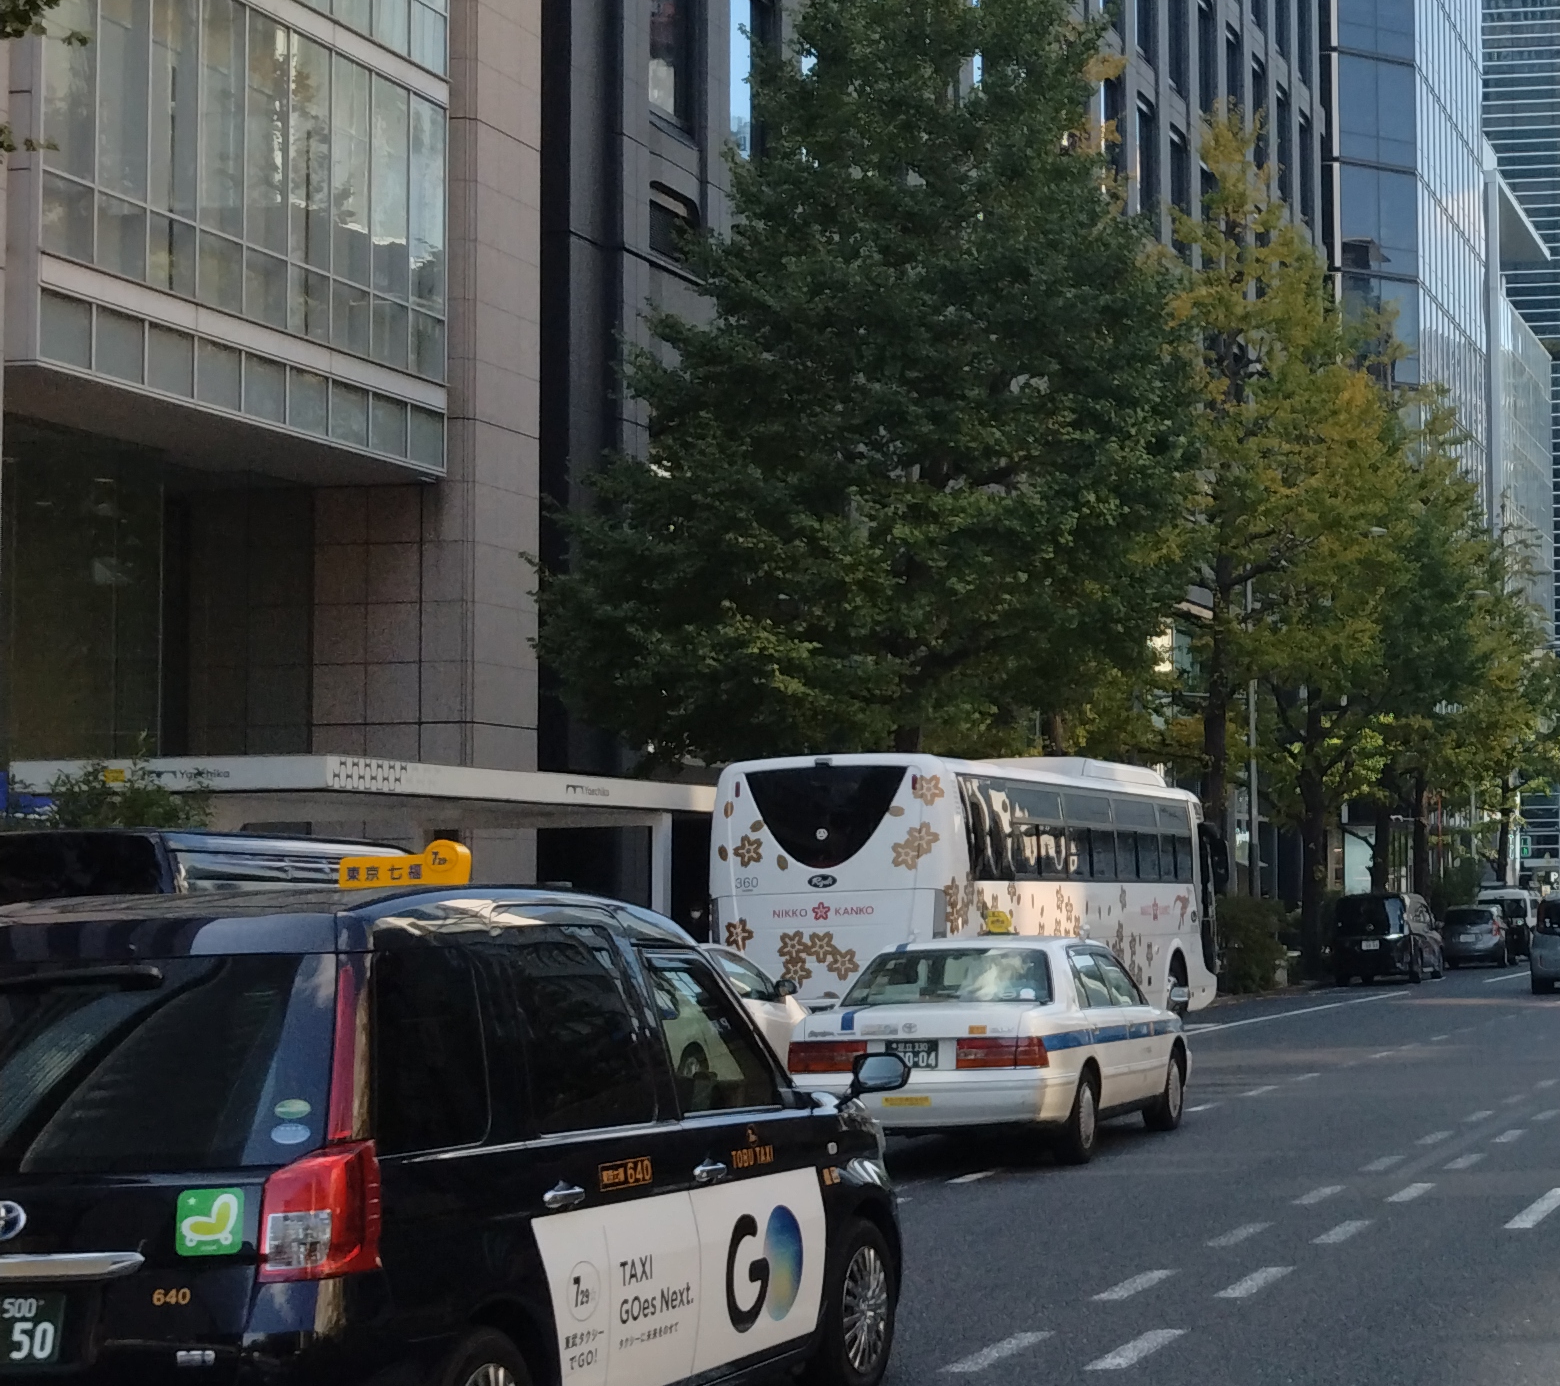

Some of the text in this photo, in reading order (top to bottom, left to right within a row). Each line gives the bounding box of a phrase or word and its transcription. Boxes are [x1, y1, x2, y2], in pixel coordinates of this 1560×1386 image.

[735, 876, 759, 889] 360
[772, 905, 875, 919] NIKKO KANKO
[730, 1143, 774, 1169] TOBU TAXI
[626, 1159, 652, 1184] 640
[619, 1254, 653, 1287] TAXI
[2, 1297, 37, 1318] 500
[152, 1286, 191, 1306] 640
[619, 1281, 694, 1325] GOes Next.
[9, 1321, 55, 1360] 50
